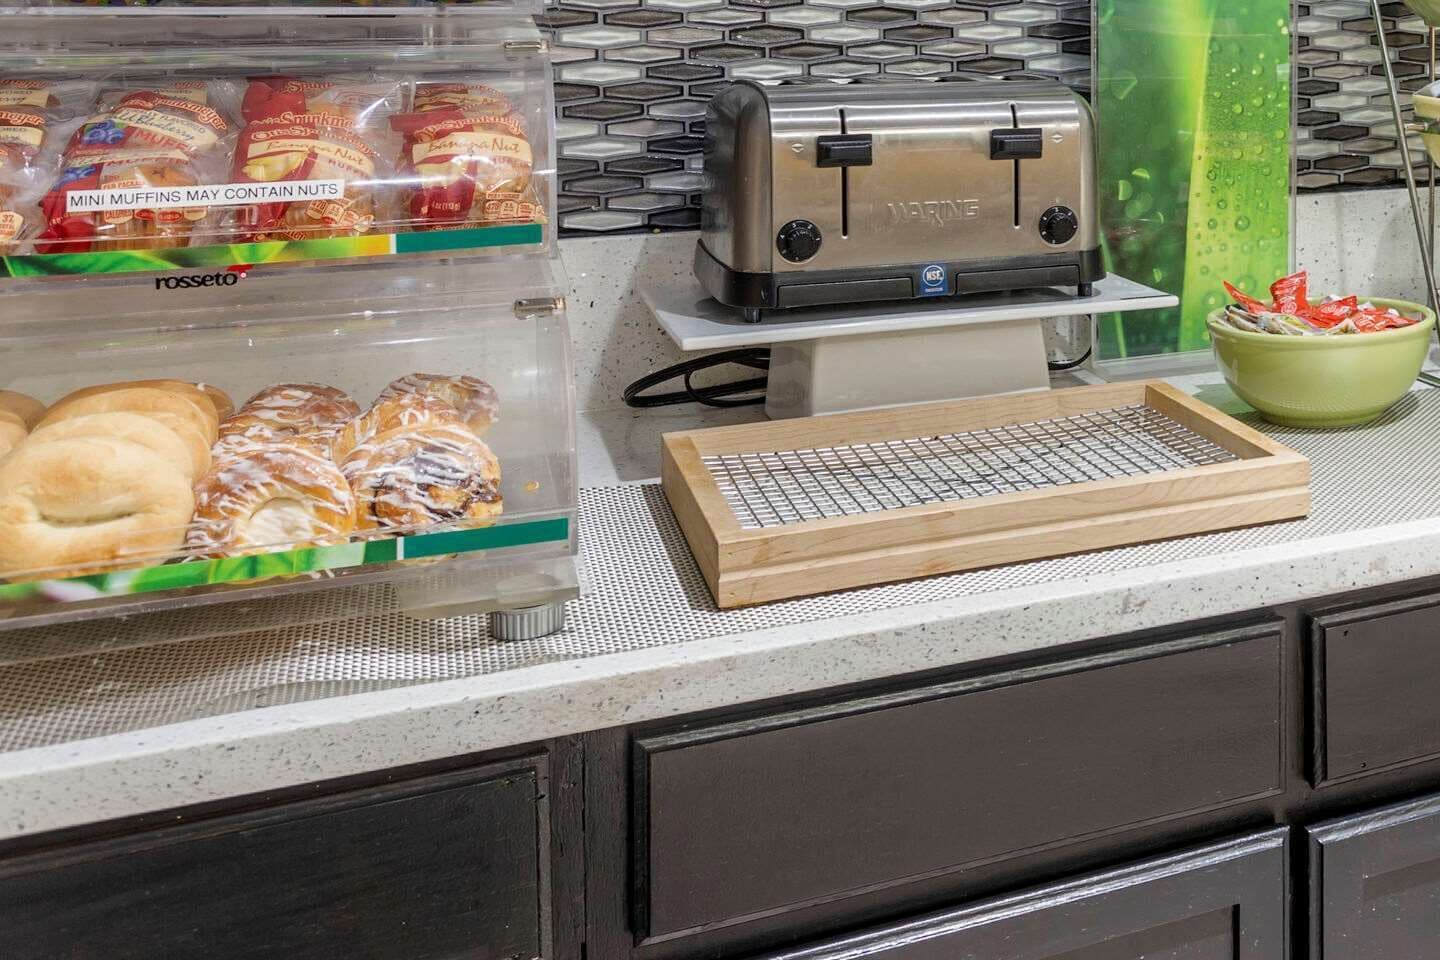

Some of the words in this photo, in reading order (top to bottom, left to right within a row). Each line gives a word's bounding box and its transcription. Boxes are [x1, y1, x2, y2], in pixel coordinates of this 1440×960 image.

[70, 194, 105, 207] MINI
[109, 190, 181, 205] MUFFINS
[186, 189, 220, 201] MAY
[224, 185, 293, 200] CONTAIN
[297, 183, 339, 196] NUTS
[886, 199, 980, 229] WARING
[154, 272, 239, 290] rosseto
[926, 270, 942, 281] NSF
